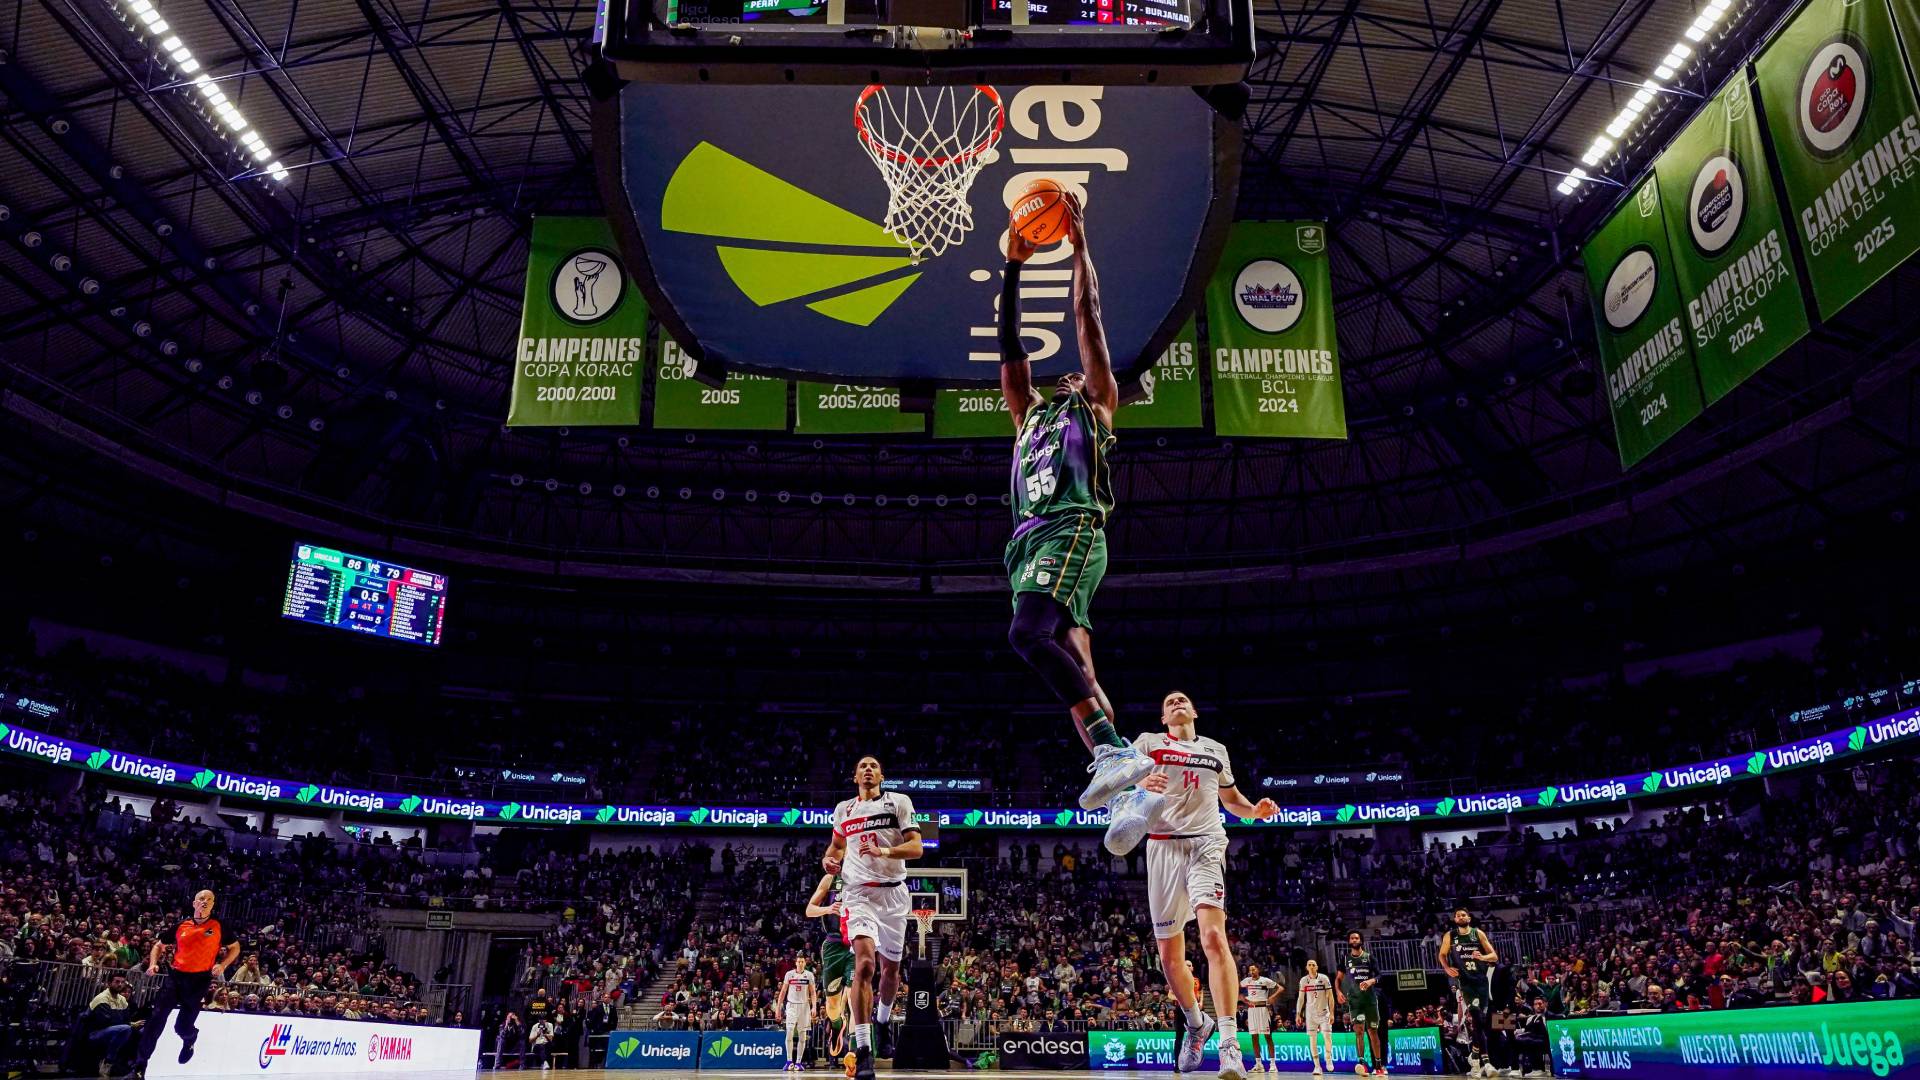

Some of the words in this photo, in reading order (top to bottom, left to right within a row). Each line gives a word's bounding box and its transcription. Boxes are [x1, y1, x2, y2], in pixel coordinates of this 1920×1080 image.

[750, 0, 779, 8] PERRY
[999, 1, 1011, 9] 24
[1126, 3, 1138, 12] 77
[1801, 114, 1920, 243] CAMPEONES
[1810, 216, 1849, 256] COPA
[1852, 187, 1886, 221] DEL
[1853, 216, 1896, 264] 2025
[1688, 229, 1782, 330] CAMPEONES
[1696, 261, 1790, 348] SUPERCOPA
[1728, 315, 1764, 354] 2024
[520, 337, 640, 362] CAMPEONES
[1609, 316, 1683, 401] CAMPEONES
[524, 363, 571, 377] COPA
[575, 363, 633, 377] KORAC
[1216, 348, 1333, 374] CAMPEONES
[1160, 367, 1195, 381] REY
[1265, 373, 1305, 381] CHAMPIONS
[536, 386, 616, 401] 2000/2001
[1262, 380, 1296, 394] BCL
[701, 390, 740, 404] 2005
[818, 393, 900, 409] 2005/2006
[1258, 398, 1299, 413] 2024
[1640, 392, 1668, 426] 2024
[1026, 466, 1057, 503] 55
[347, 559, 362, 570] 86
[368, 563, 381, 574] VS
[386, 568, 400, 579] 79
[360, 590, 380, 603] 0.5
[1869, 710, 1920, 743] Unicaj
[9, 729, 72, 763] Unicaja
[1769, 739, 1834, 768] Unicaja
[111, 753, 176, 785] Unicaja
[511, 772, 535, 781] Unicaja
[1377, 773, 1402, 782] Unicaja
[1664, 762, 1731, 788] Unicaja
[216, 773, 281, 800] Unicaja
[562, 776, 586, 784] Unicaja
[1182, 770, 1200, 789] 14
[1273, 777, 1297, 786] Unicaja
[1325, 775, 1350, 784] Unicaja
[320, 788, 384, 812] Unicaja
[1561, 780, 1626, 804] Unicaja
[422, 799, 485, 820] Unicaja
[1358, 802, 1420, 822] Unicaja
[1458, 793, 1522, 815] Unicaja
[522, 804, 582, 825] Unicaja
[617, 807, 675, 826] Unicaja
[710, 809, 768, 828] Unicaja
[802, 809, 834, 825] Unic
[984, 811, 1041, 829] Unicaja
[1003, 1036, 1084, 1055] endesa
[1394, 1035, 1437, 1050] AYUNTAMIENTO
[1580, 1027, 1663, 1047] AYUNTAMIENTO
[290, 1035, 332, 1056] Navarro
[331, 1037, 357, 1056] Hnos.
[379, 1036, 413, 1060] YAMAHA
[641, 1043, 692, 1060] Unicaja
[733, 1042, 783, 1059] Unicaja
[1679, 1033, 1740, 1064] NUESTRA
[1740, 1032, 1823, 1065] PROVINCIA
[1821, 1021, 1904, 1077] Juega
[1136, 1053, 1154, 1064] DE
[1396, 1052, 1404, 1066] DE
[1403, 1052, 1422, 1066] MIJAS
[1583, 1051, 1598, 1069] DE
[1599, 1051, 1632, 1070] MIJAS
